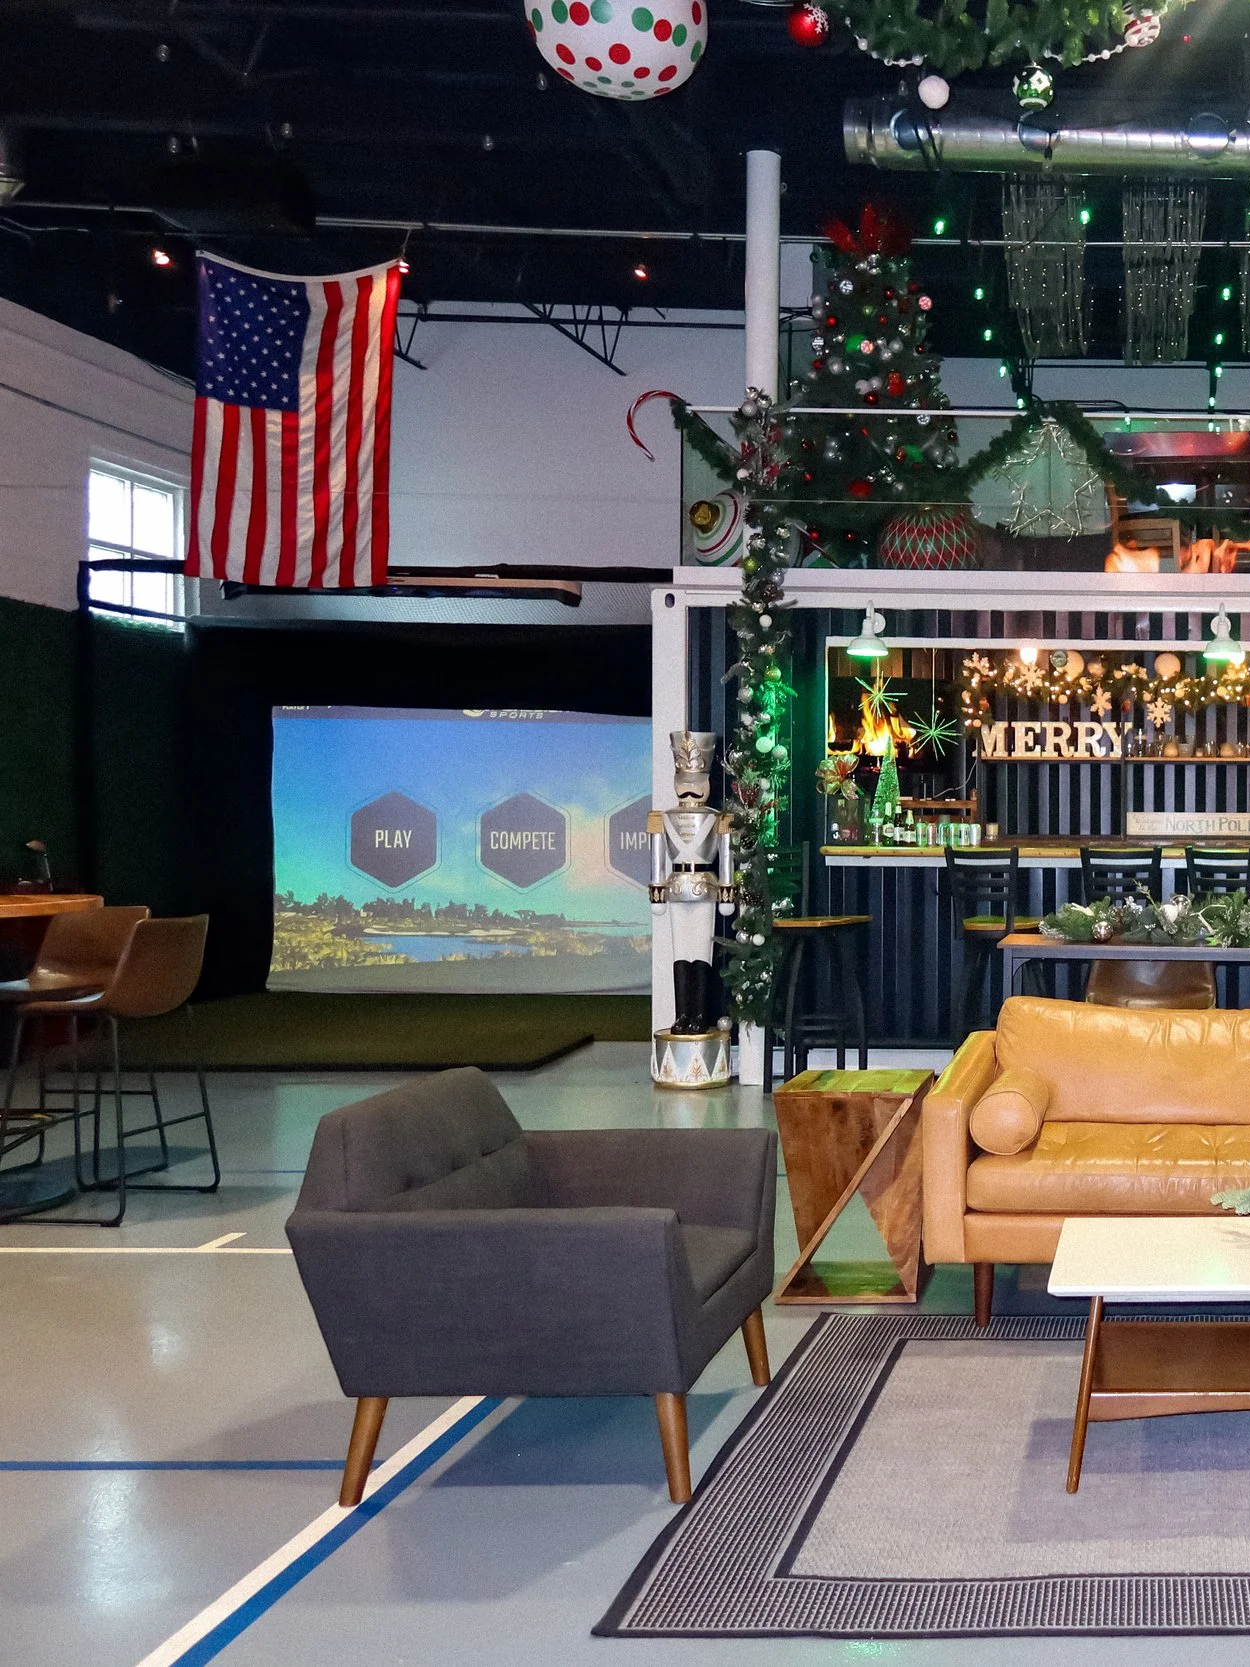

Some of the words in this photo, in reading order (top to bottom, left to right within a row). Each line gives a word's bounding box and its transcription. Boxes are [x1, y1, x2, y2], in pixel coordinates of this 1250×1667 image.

[489, 711, 544, 720] SPORTS
[972, 721, 1133, 758] MERRY
[1165, 815, 1216, 834] NORTH
[375, 829, 412, 849] PLAY
[490, 831, 556, 851] COMPETE
